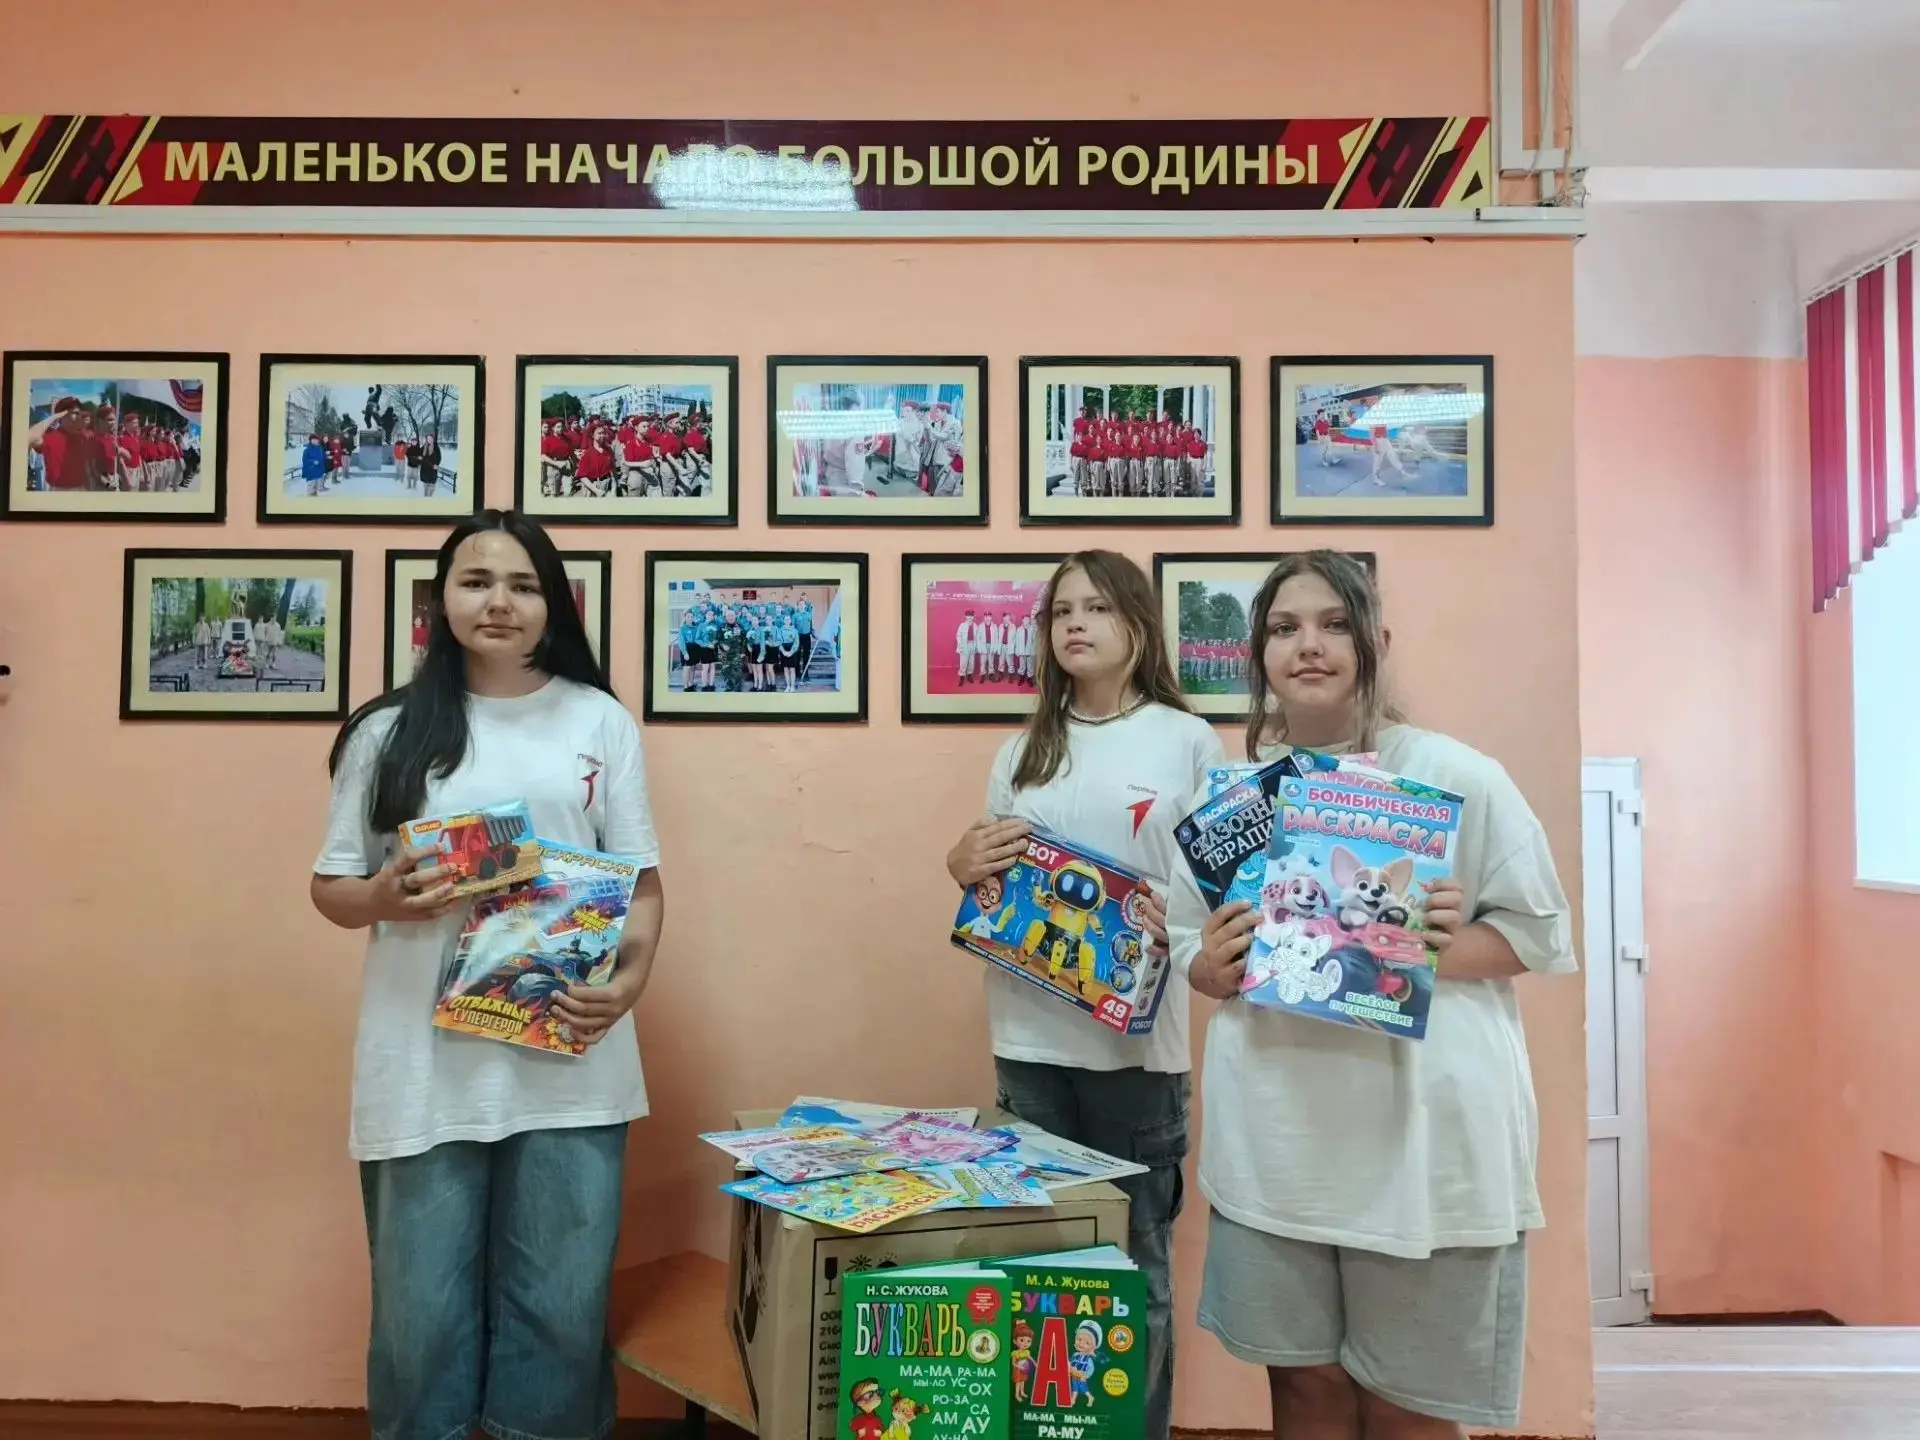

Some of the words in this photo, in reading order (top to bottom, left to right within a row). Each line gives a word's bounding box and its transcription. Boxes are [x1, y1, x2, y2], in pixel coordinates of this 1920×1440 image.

[164, 141, 507, 183] МАЛЕНЬКОЕ
[779, 137, 1059, 186] БОЛЬШОЙ
[1078, 144, 1317, 194] РОДИНЫ
[1200, 787, 1258, 827] РАСКРАСКА
[1308, 787, 1450, 822] БОМБИЧЕСКАЯ
[1190, 794, 1278, 860] СКАЗОЧНА
[1282, 804, 1449, 859] РАСКРАСКА
[1026, 842, 1059, 864] БОТ
[1204, 819, 1274, 871] ТЕРАПИ
[449, 995, 532, 1023] ОТВАЖНЫЕ
[1102, 998, 1127, 1019] 49
[1345, 991, 1400, 1012] ВЕСЁЛОЕ
[454, 1008, 523, 1034] СУПЕРГЕРОИ
[1329, 1000, 1413, 1027] ПУТЕШЕСТВИЕ
[867, 1286, 878, 1295] Н.
[881, 1286, 892, 1295] С.
[895, 1285, 948, 1296] ЖУКОВА
[1026, 1275, 1040, 1285] М.
[1045, 1275, 1057, 1286] А.
[1061, 1276, 1110, 1290] Жукова
[1011, 1291, 1130, 1317] БУКВАРЬ
[854, 1301, 966, 1357] БУКВАРЬ
[900, 1365, 952, 1376] МА-МА
[958, 1367, 996, 1377] РА-МА
[913, 1379, 946, 1387] МЫ-ЛО
[951, 1377, 967, 1387] УС
[969, 1383, 992, 1396] ОХ
[933, 1395, 970, 1405] РО-ЗА
[970, 1404, 989, 1415] СА
[932, 1412, 958, 1424] АМ
[961, 1416, 991, 1434] АУ
[1023, 1412, 1055, 1422] МА-МА
[1064, 1414, 1097, 1425] МЫ-ЛА
[1038, 1425, 1084, 1439] РА-МУ
